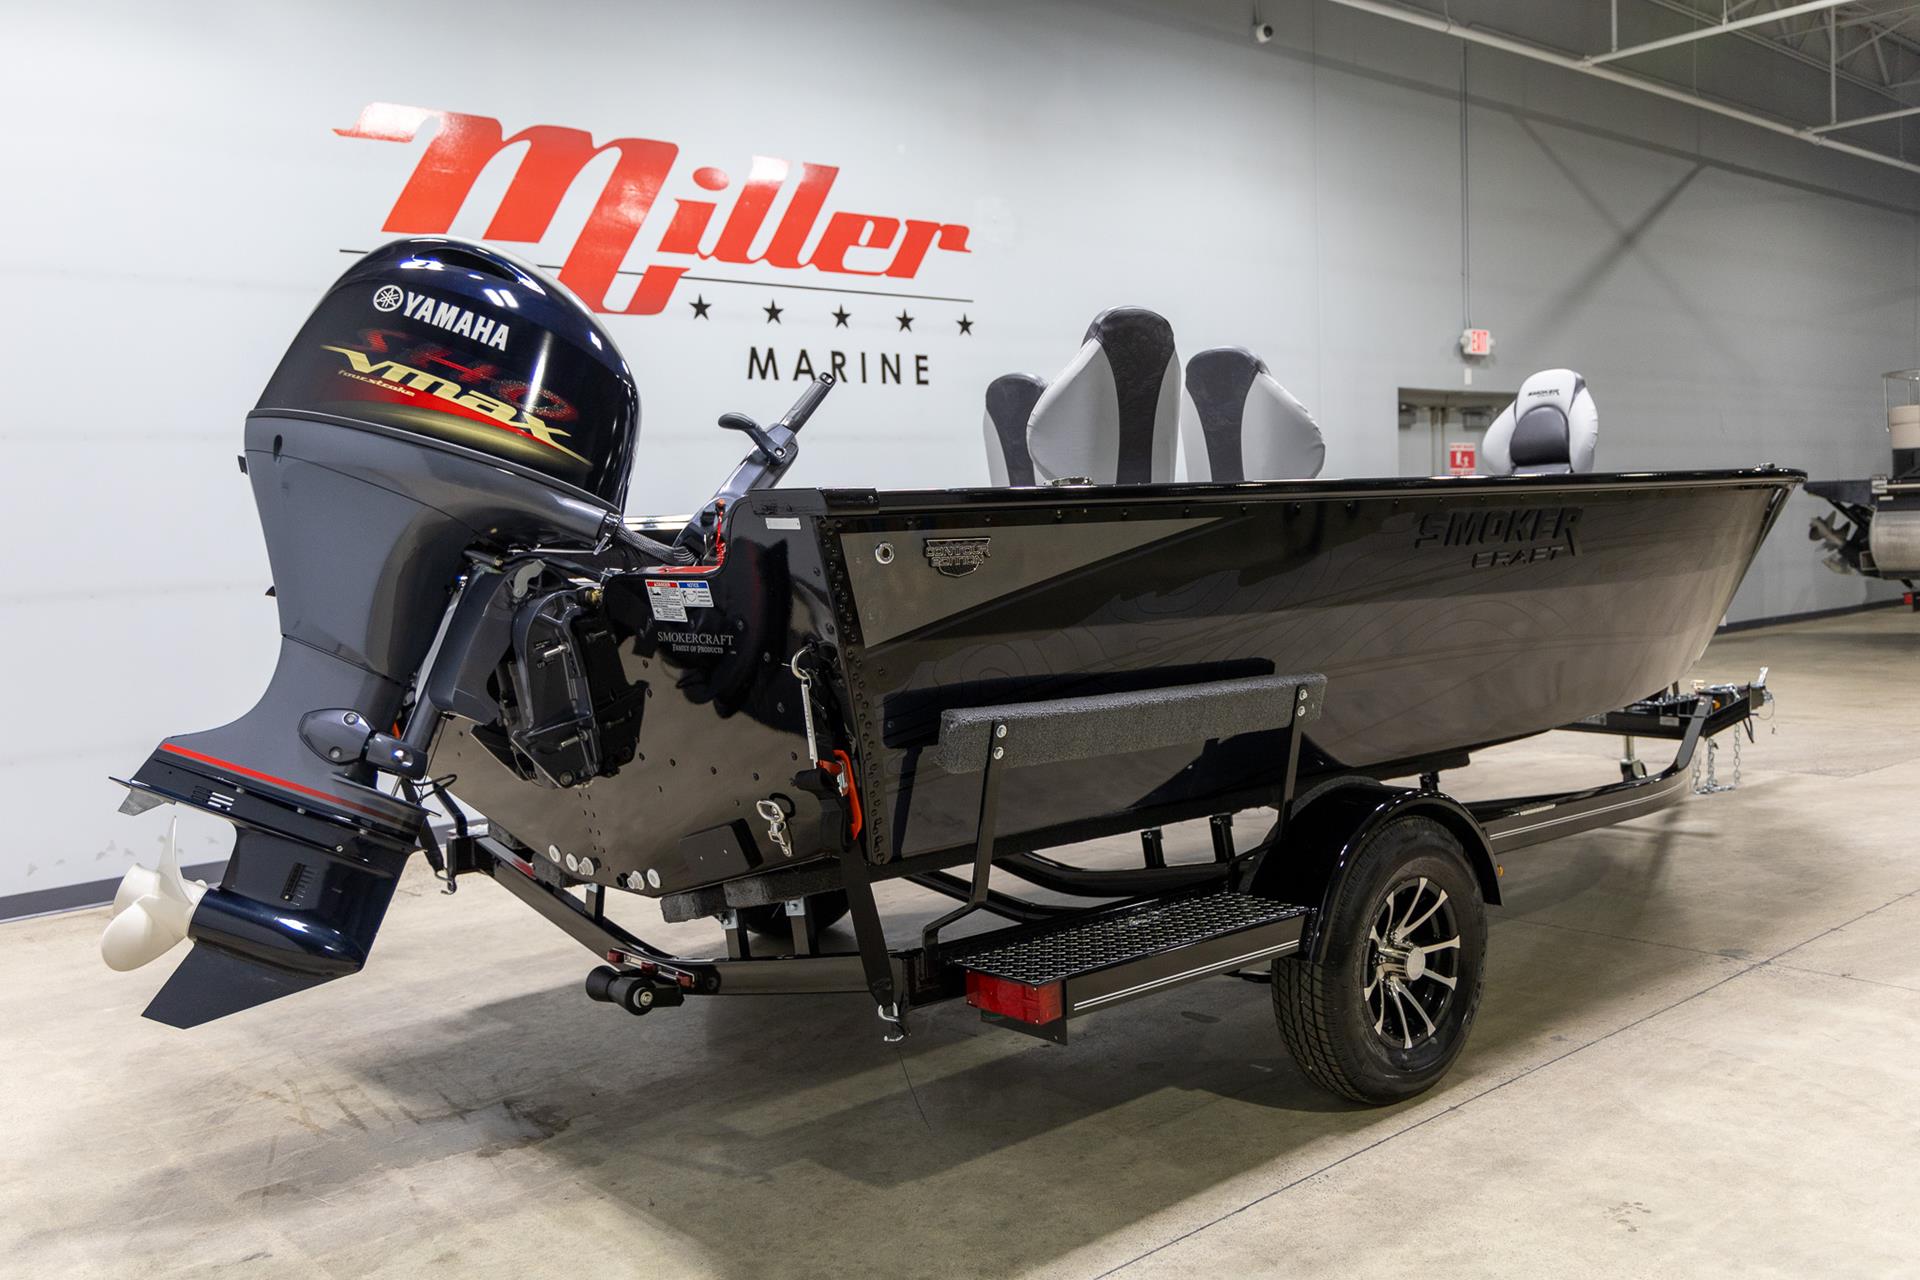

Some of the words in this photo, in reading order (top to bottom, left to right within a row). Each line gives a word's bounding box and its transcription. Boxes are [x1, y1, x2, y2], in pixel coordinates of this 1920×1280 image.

[333, 102, 972, 315] Miller
[404, 292, 510, 351] YAMAHA
[748, 346, 929, 385] MARINE
[1414, 507, 1584, 557] SMOKER
[1471, 546, 1565, 569] CRAFT
[657, 631, 734, 646] SMOKERCRAFT
